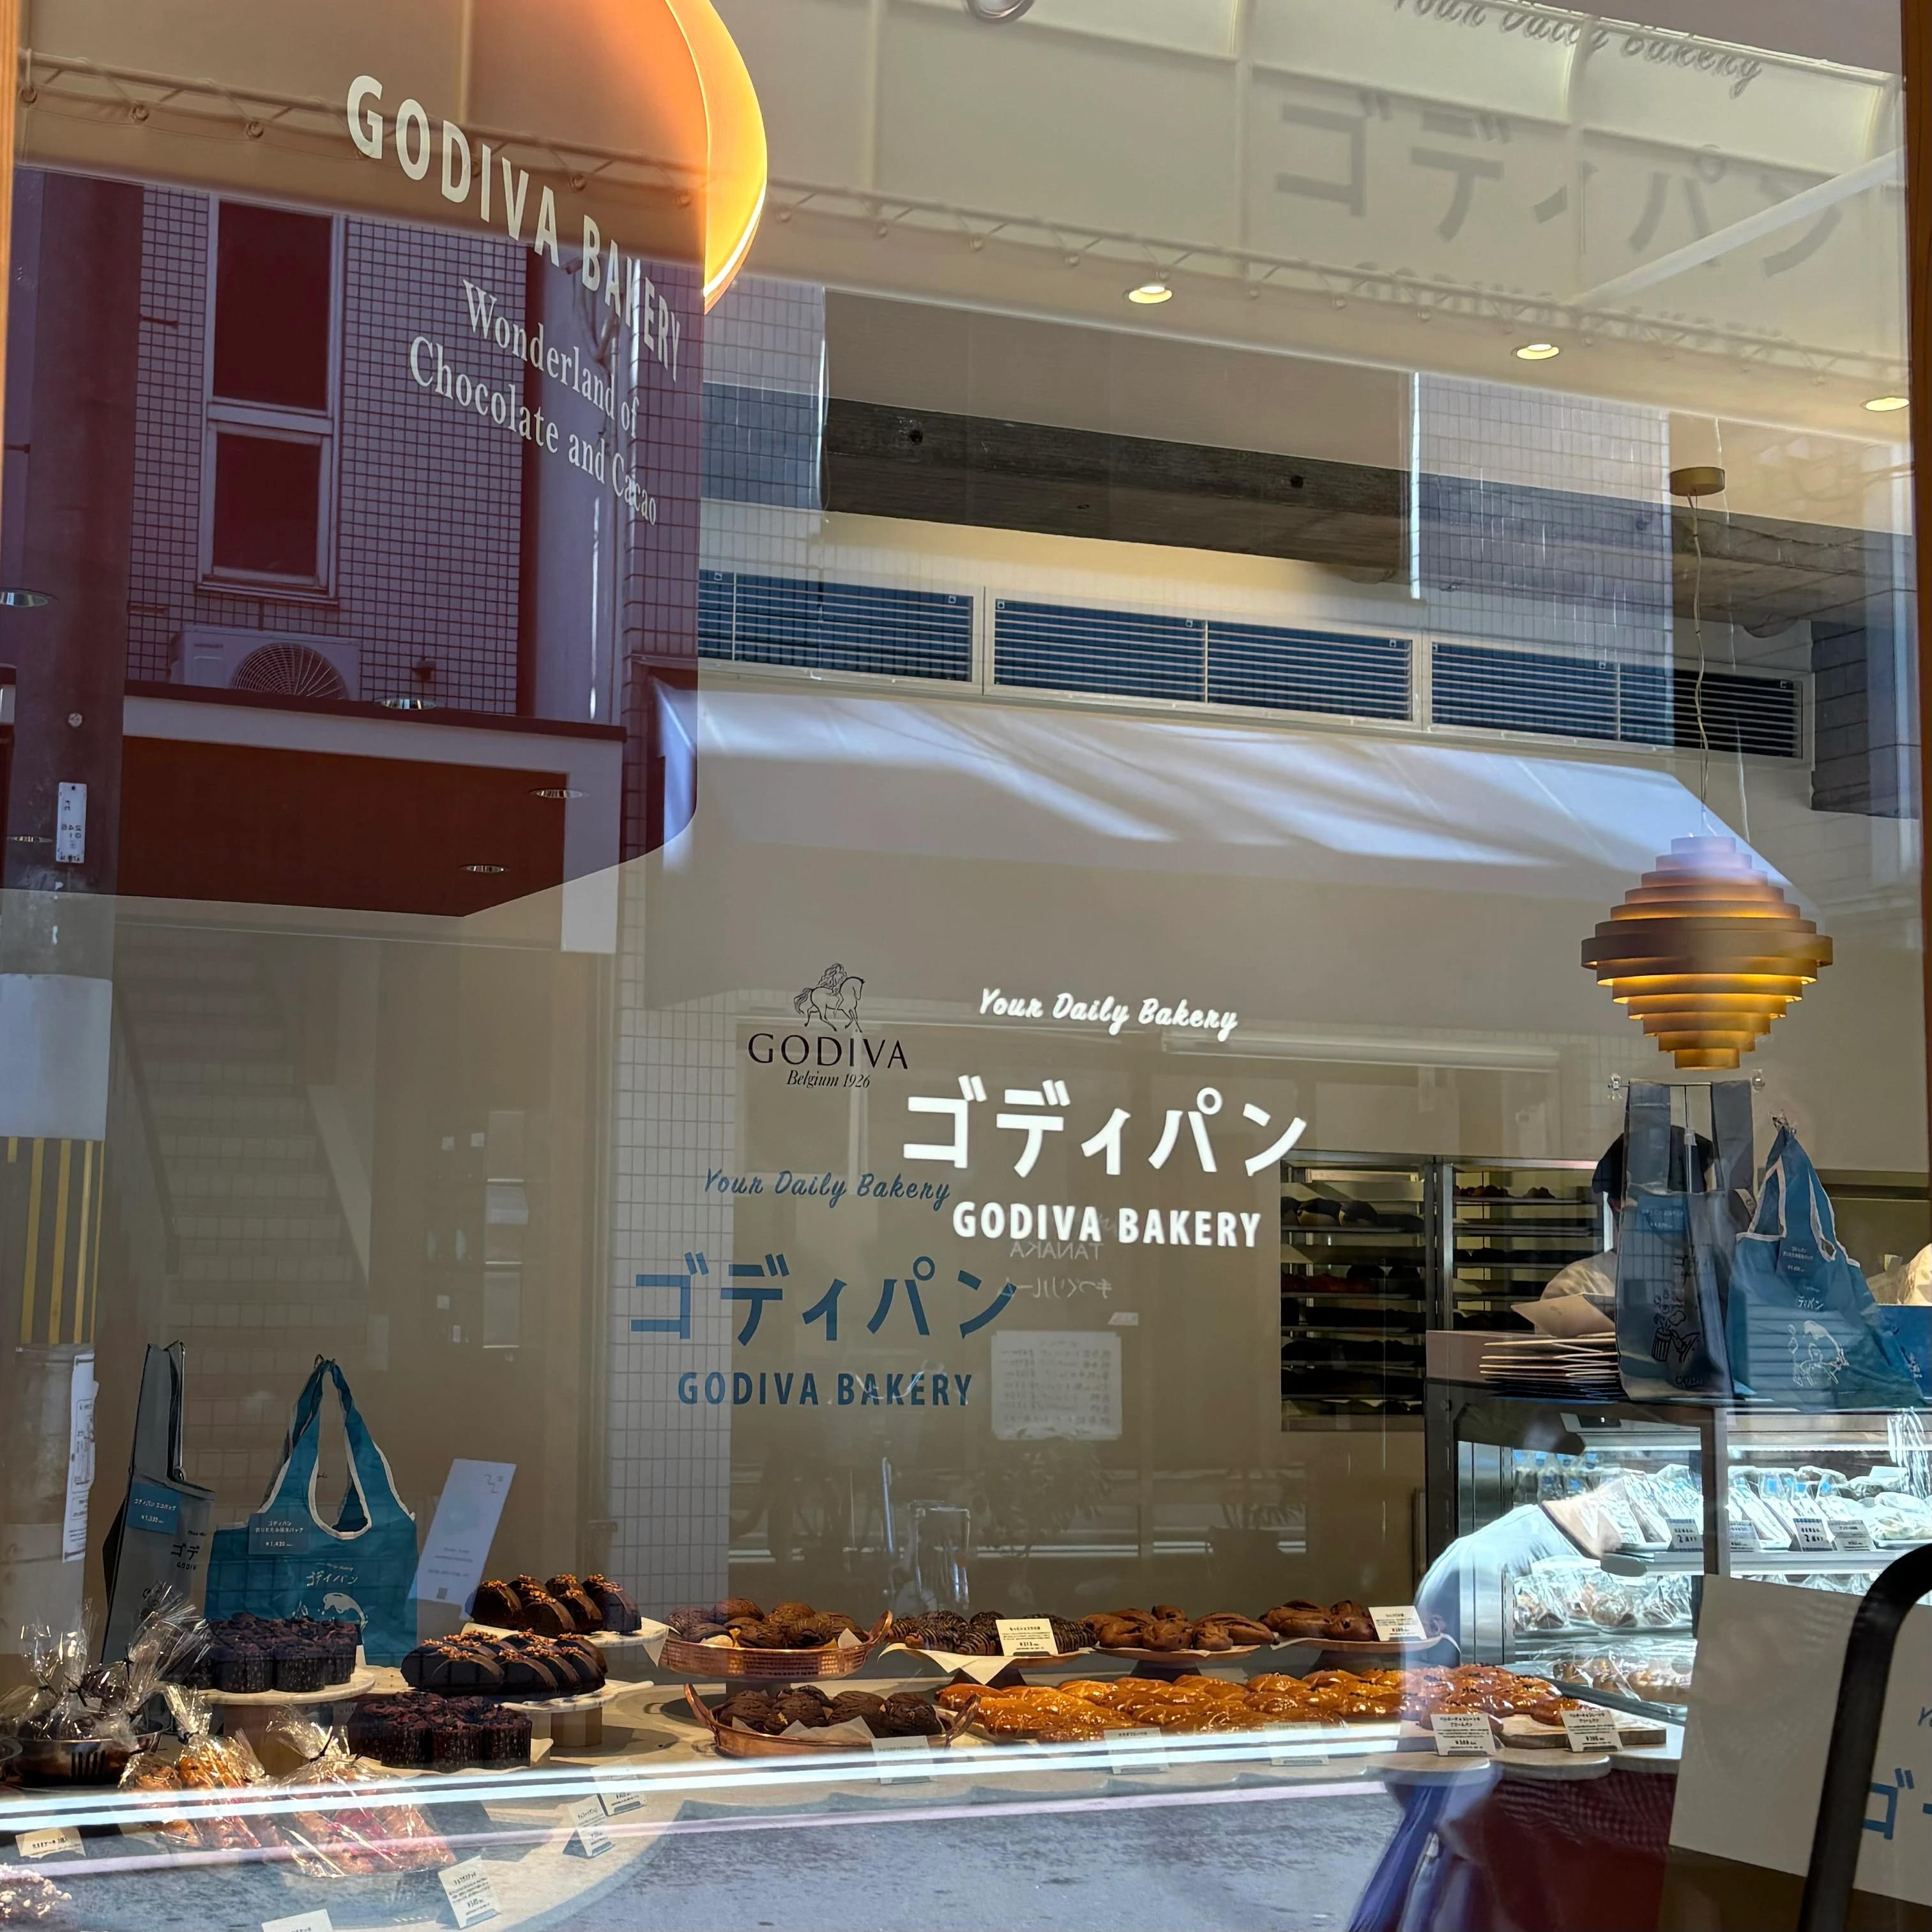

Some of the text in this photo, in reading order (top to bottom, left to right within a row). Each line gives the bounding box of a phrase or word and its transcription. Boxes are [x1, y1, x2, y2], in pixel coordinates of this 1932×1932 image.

[347, 75, 680, 382] GODIVA BAKERY
[462, 278, 640, 439] Wonderland of
[409, 336, 657, 526] Chocolate and Cacao
[979, 987, 1238, 1042] Your Daily Bakery
[748, 1033, 908, 1070] GODIVA
[786, 1070, 871, 1089] Belgium 1926
[903, 1074, 1307, 1177] ゴディパン
[704, 1168, 951, 1212] Your Daily Bakery
[952, 1201, 1101, 1242] GODIVA
[1118, 1206, 1261, 1248] BAKERY
[630, 1251, 1017, 1346] ゴディパン
[678, 1372, 973, 1406] GODIVA BAKERY
